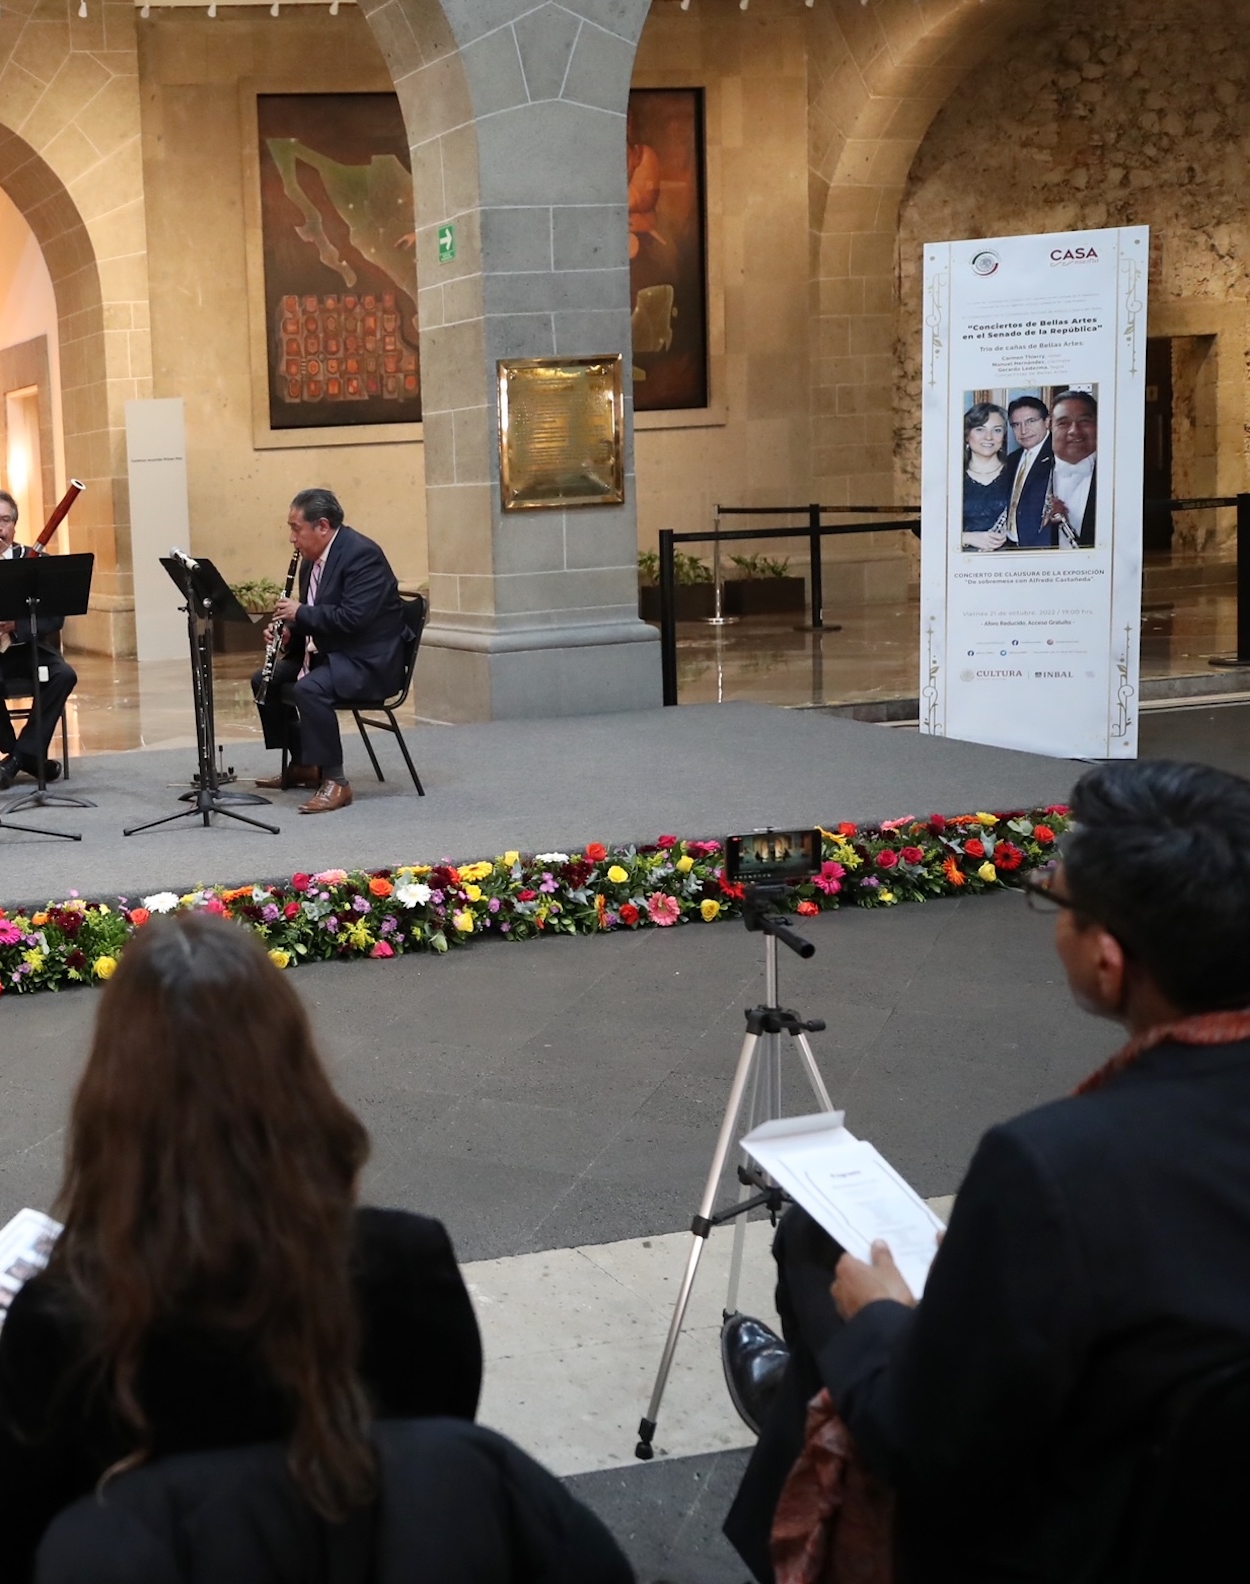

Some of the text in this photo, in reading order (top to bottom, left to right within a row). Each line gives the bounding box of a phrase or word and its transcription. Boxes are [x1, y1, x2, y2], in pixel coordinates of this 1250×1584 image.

[1050, 247, 1098, 261] CASA
[1040, 319, 1068, 327] Bellas
[988, 330, 1022, 338] Senado
